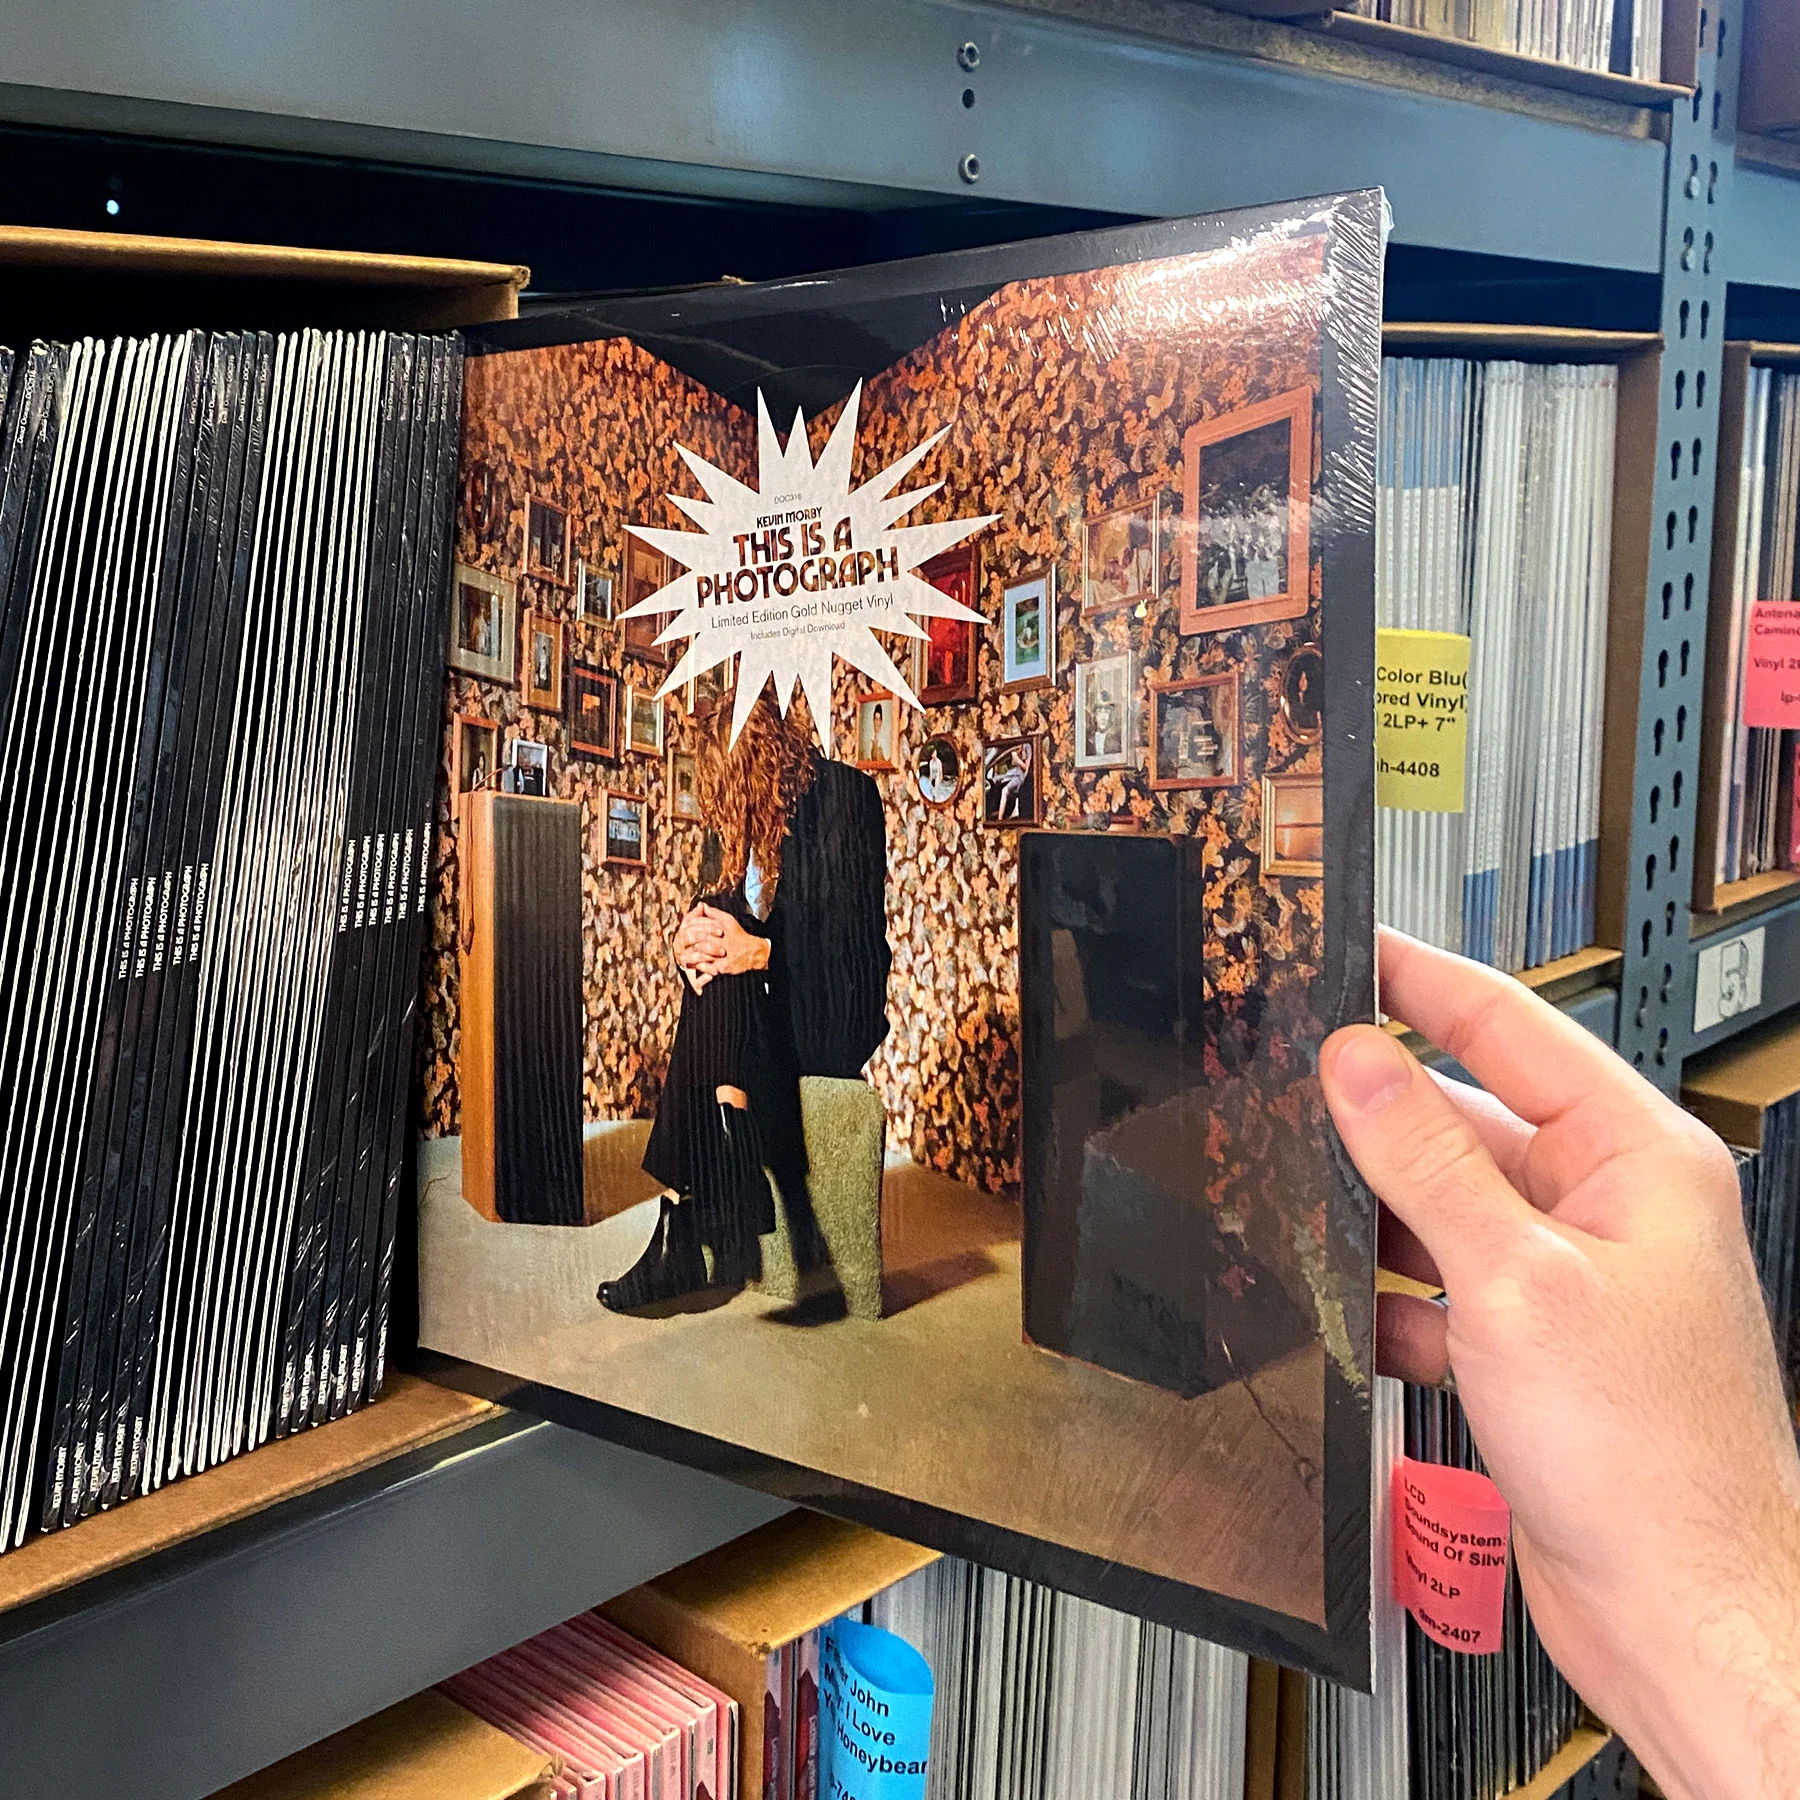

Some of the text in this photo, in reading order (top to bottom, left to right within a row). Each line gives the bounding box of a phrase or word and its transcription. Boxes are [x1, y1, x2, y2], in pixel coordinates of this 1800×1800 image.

[756, 506, 822, 528] KEVIN MORBY
[733, 516, 852, 567] THIS IS A
[696, 546, 899, 608] PHOTOGRAPH
[711, 593, 894, 628] Limited Edition Gold Nugget Vinyl
[750, 622, 845, 641] Includes Digital Download
[1376, 666, 1423, 684] Color
[1754, 658, 1784, 672] Vinyl
[1384, 713, 1428, 729] 2LP+
[421, 823, 431, 878] PHOTOGRAPH
[344, 840, 355, 896] PHOTOGRAPH
[355, 910, 363, 928] THIS
[359, 836, 370, 892] PHOTOGRAPH
[369, 908, 377, 925] THIS
[373, 834, 384, 890] PHOTOGRAPH
[384, 906, 392, 924] THIS
[388, 833, 399, 889] PHOTOGRAPH
[398, 902, 406, 919] THIS
[402, 829, 413, 884] PHOTOGRAPH
[125, 878, 138, 940] PHOTOGRAPH
[179, 866, 192, 927] PHOTOGRAPH
[195, 863, 208, 924] PHOTOGRAPH
[341, 905, 348, 913] IS
[135, 958, 145, 978] THIS
[141, 877, 155, 939] PHOTOGRAPH
[153, 952, 162, 971] THIS
[158, 872, 172, 933] PHOTOGRAPH
[192, 933, 199, 941] IS
[339, 914, 347, 932] THIS
[122, 950, 129, 958] IS
[173, 946, 182, 965] THIS
[176, 936, 183, 944] IS
[189, 943, 198, 961] THIS
[119, 960, 127, 979] THIS
[115, 1424, 125, 1456] MORBY
[56, 1447, 66, 1480] MORBY
[1404, 1476, 1426, 1505] LCD
[1444, 1546, 1464, 1562] Of
[1430, 1578, 1460, 1599] 2LP
[850, 1680, 889, 1718] John
[853, 1709, 896, 1746] Love
[836, 1719, 928, 1774] Honeybear
